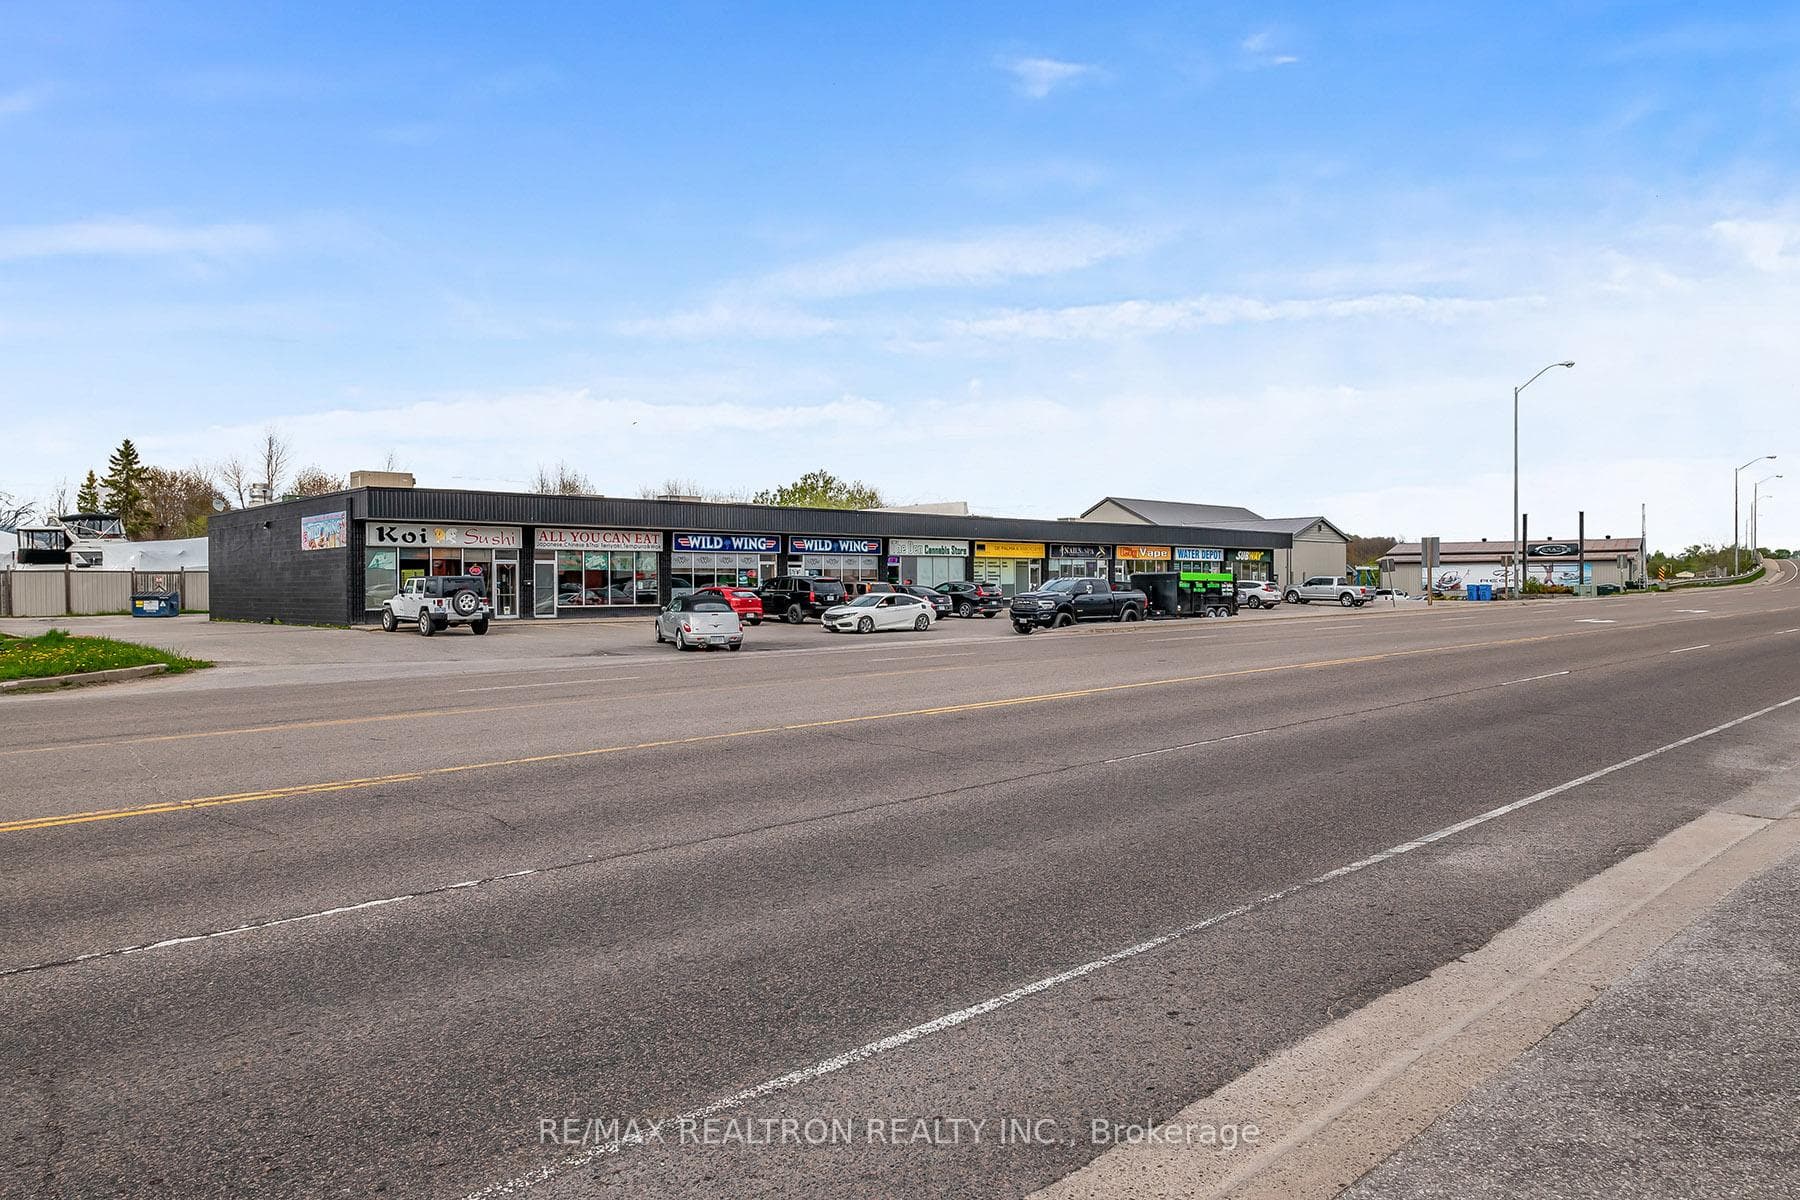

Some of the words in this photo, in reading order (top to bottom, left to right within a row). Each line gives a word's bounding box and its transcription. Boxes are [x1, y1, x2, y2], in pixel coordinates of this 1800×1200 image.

[376, 525, 427, 544] Koi
[463, 528, 516, 546] Sushi
[539, 531, 567, 542] ALL
[570, 532, 600, 543] YOU
[602, 532, 631, 544] CAN
[635, 533, 660, 544] EAT
[687, 536, 723, 549] WILD
[731, 537, 767, 551] WING
[803, 538, 832, 551] WILD
[838, 540, 869, 552] WING
[951, 546, 967, 555] Store
[1140, 547, 1168, 558] Vape
[1178, 550, 1200, 560] WATER
[1202, 550, 1221, 560] DEPOT
[1235, 551, 1264, 561] SUBWAY
